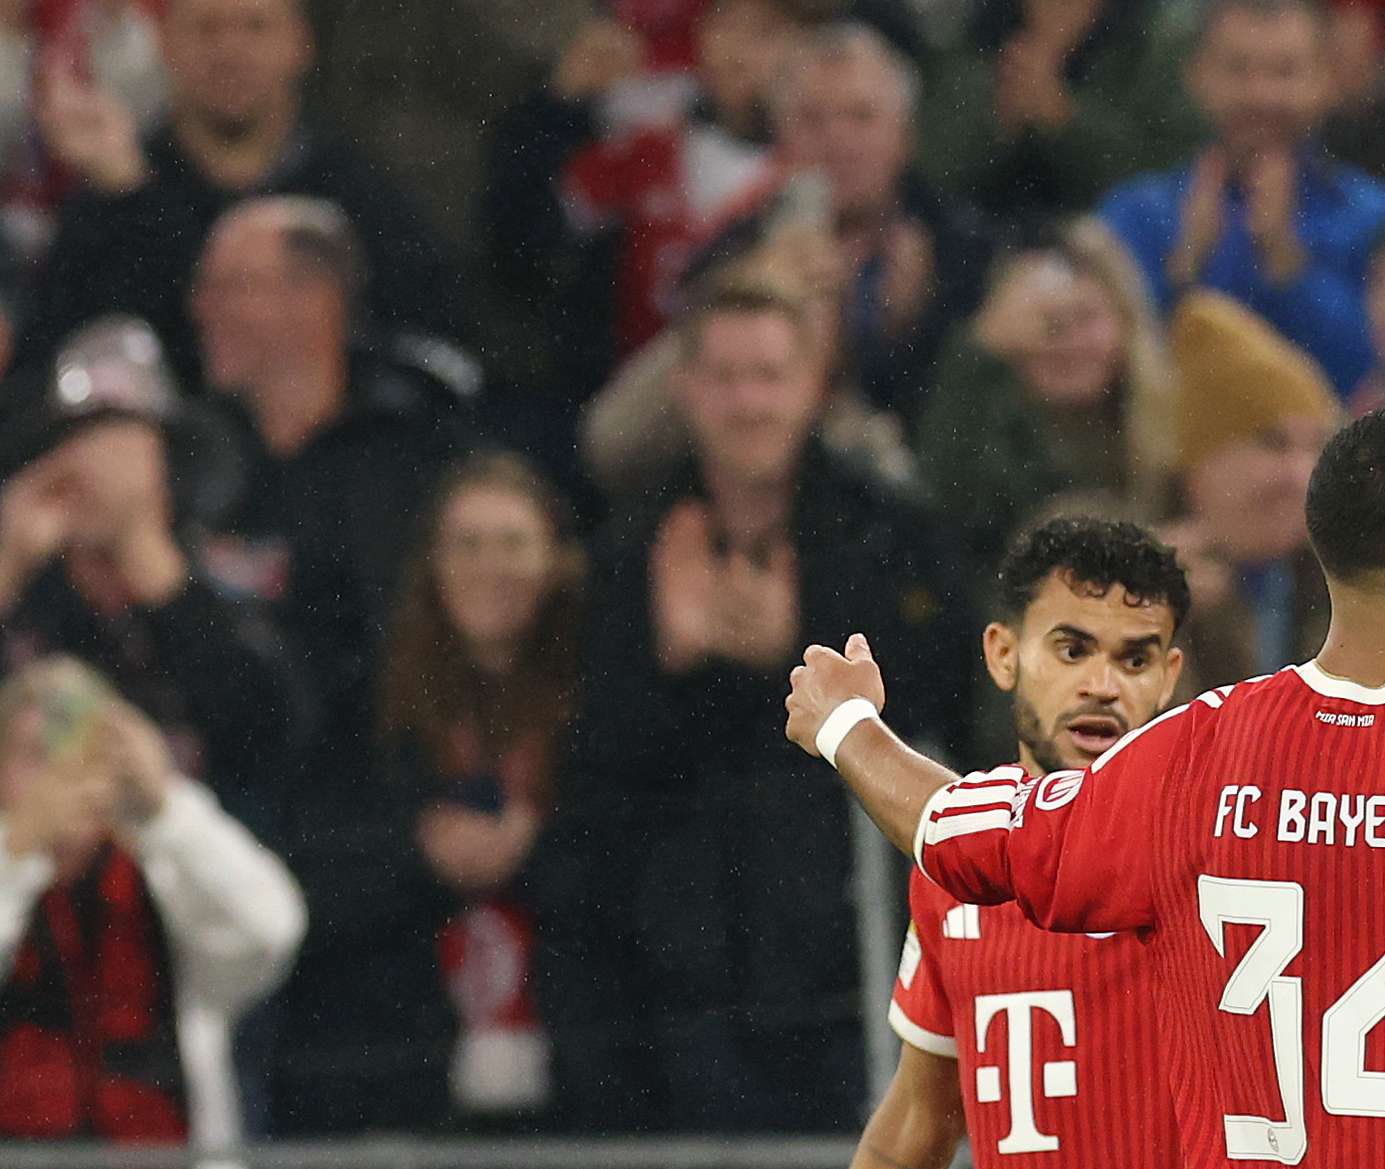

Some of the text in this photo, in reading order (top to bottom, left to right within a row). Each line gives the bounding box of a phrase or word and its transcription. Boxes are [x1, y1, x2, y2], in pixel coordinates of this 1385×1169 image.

[1315, 711, 1375, 727] MIA SAN MIA
[1214, 785, 1261, 839] FC
